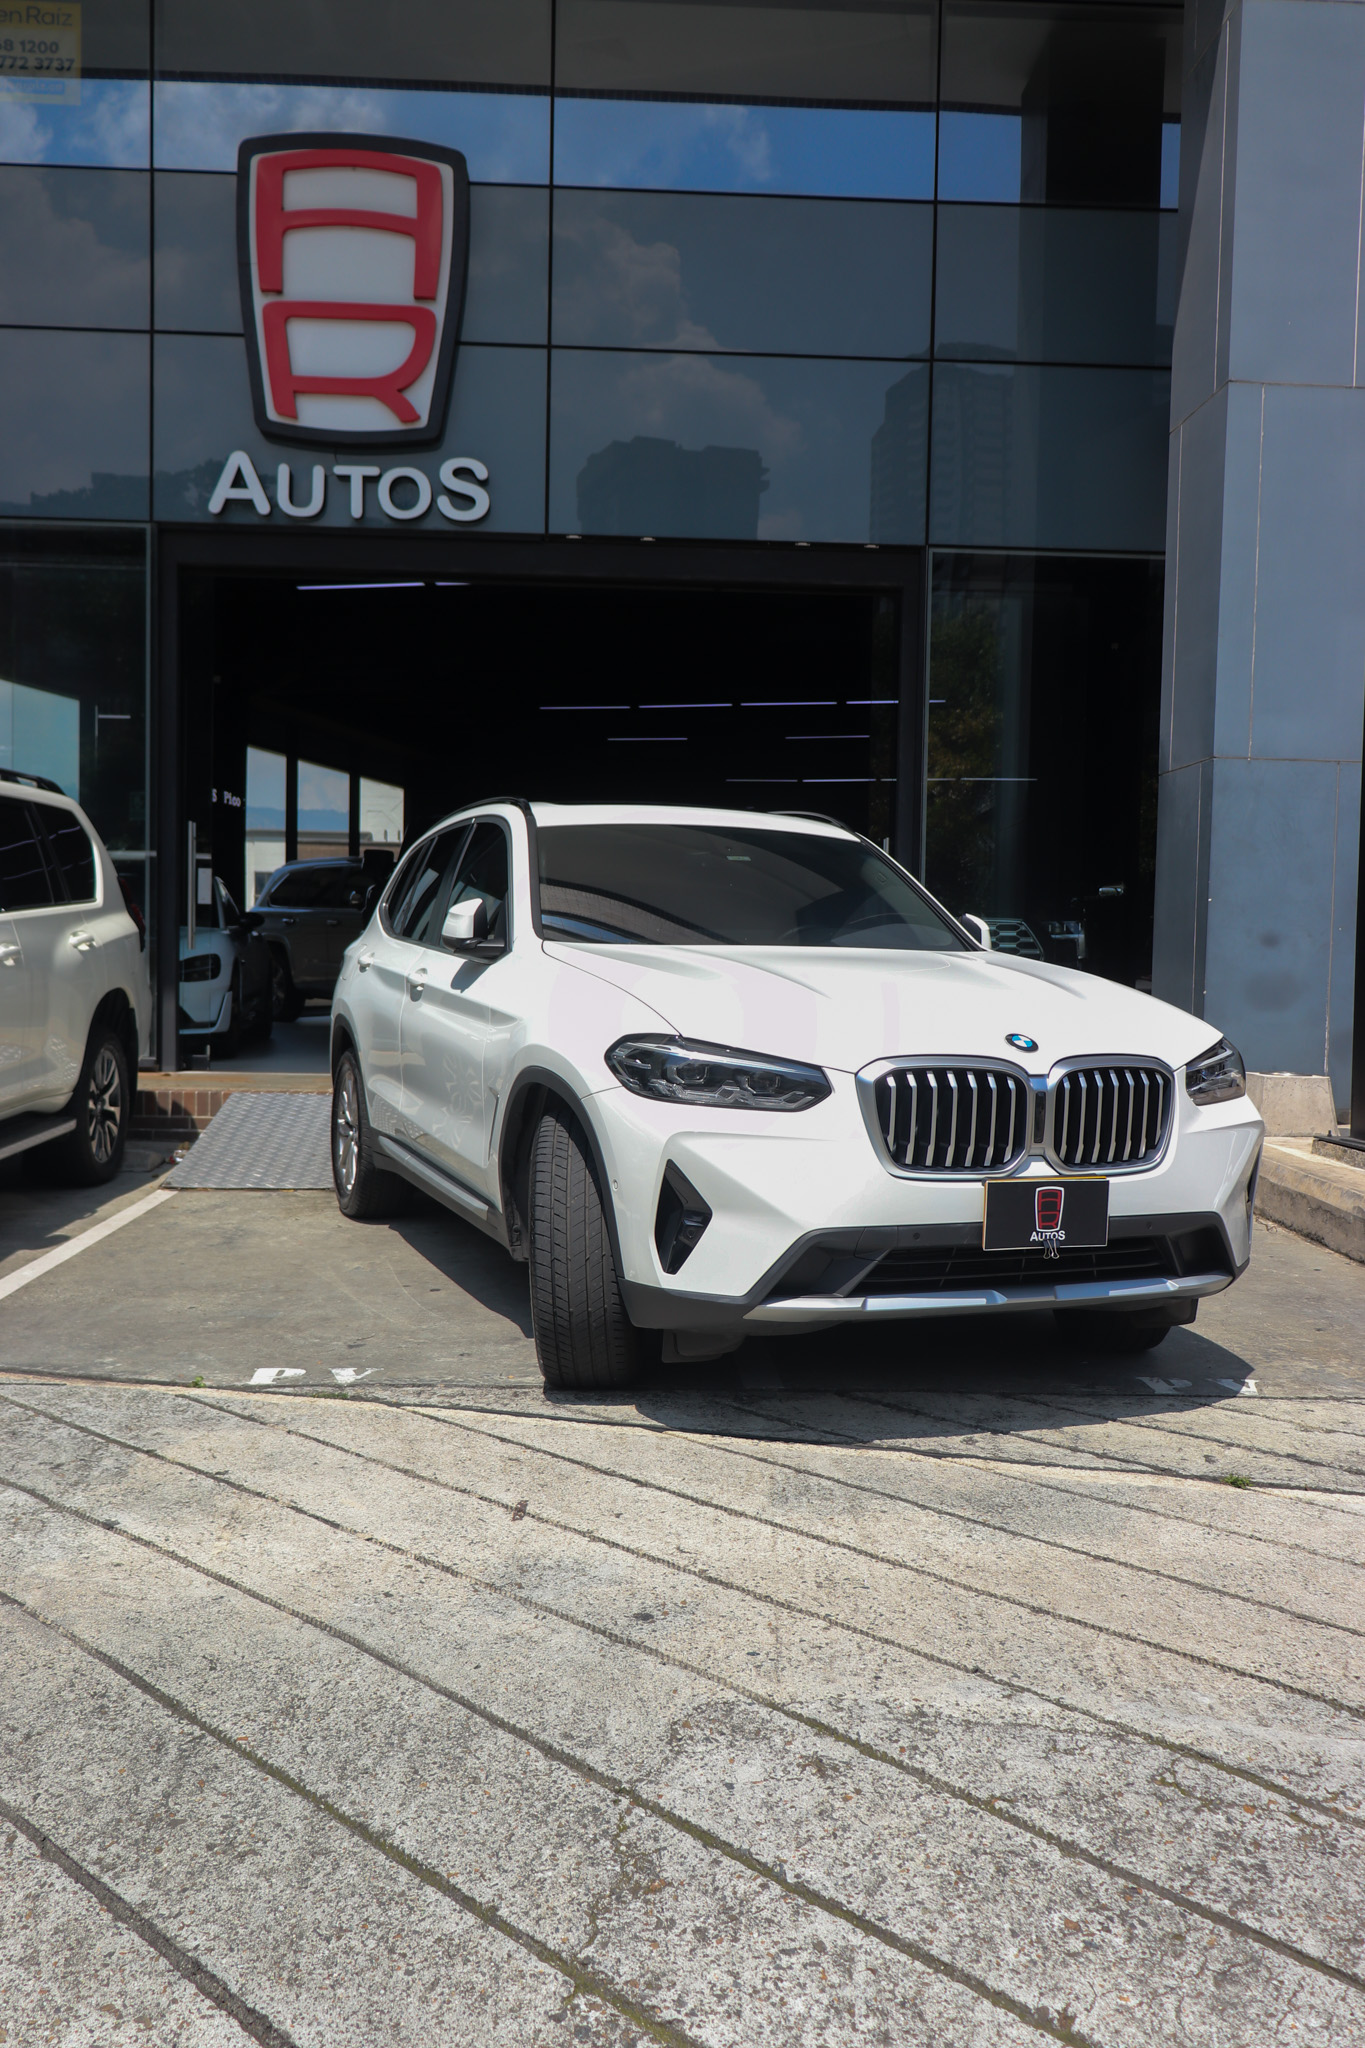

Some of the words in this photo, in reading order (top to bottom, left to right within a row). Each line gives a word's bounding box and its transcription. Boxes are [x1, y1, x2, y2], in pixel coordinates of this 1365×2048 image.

[0, 38, 14, 52] 8
[19, 39, 59, 54] 1200
[34, 57, 75, 71] 3737
[207, 449, 491, 522] AUTOS
[1029, 1230, 1066, 1242] AUTOS
